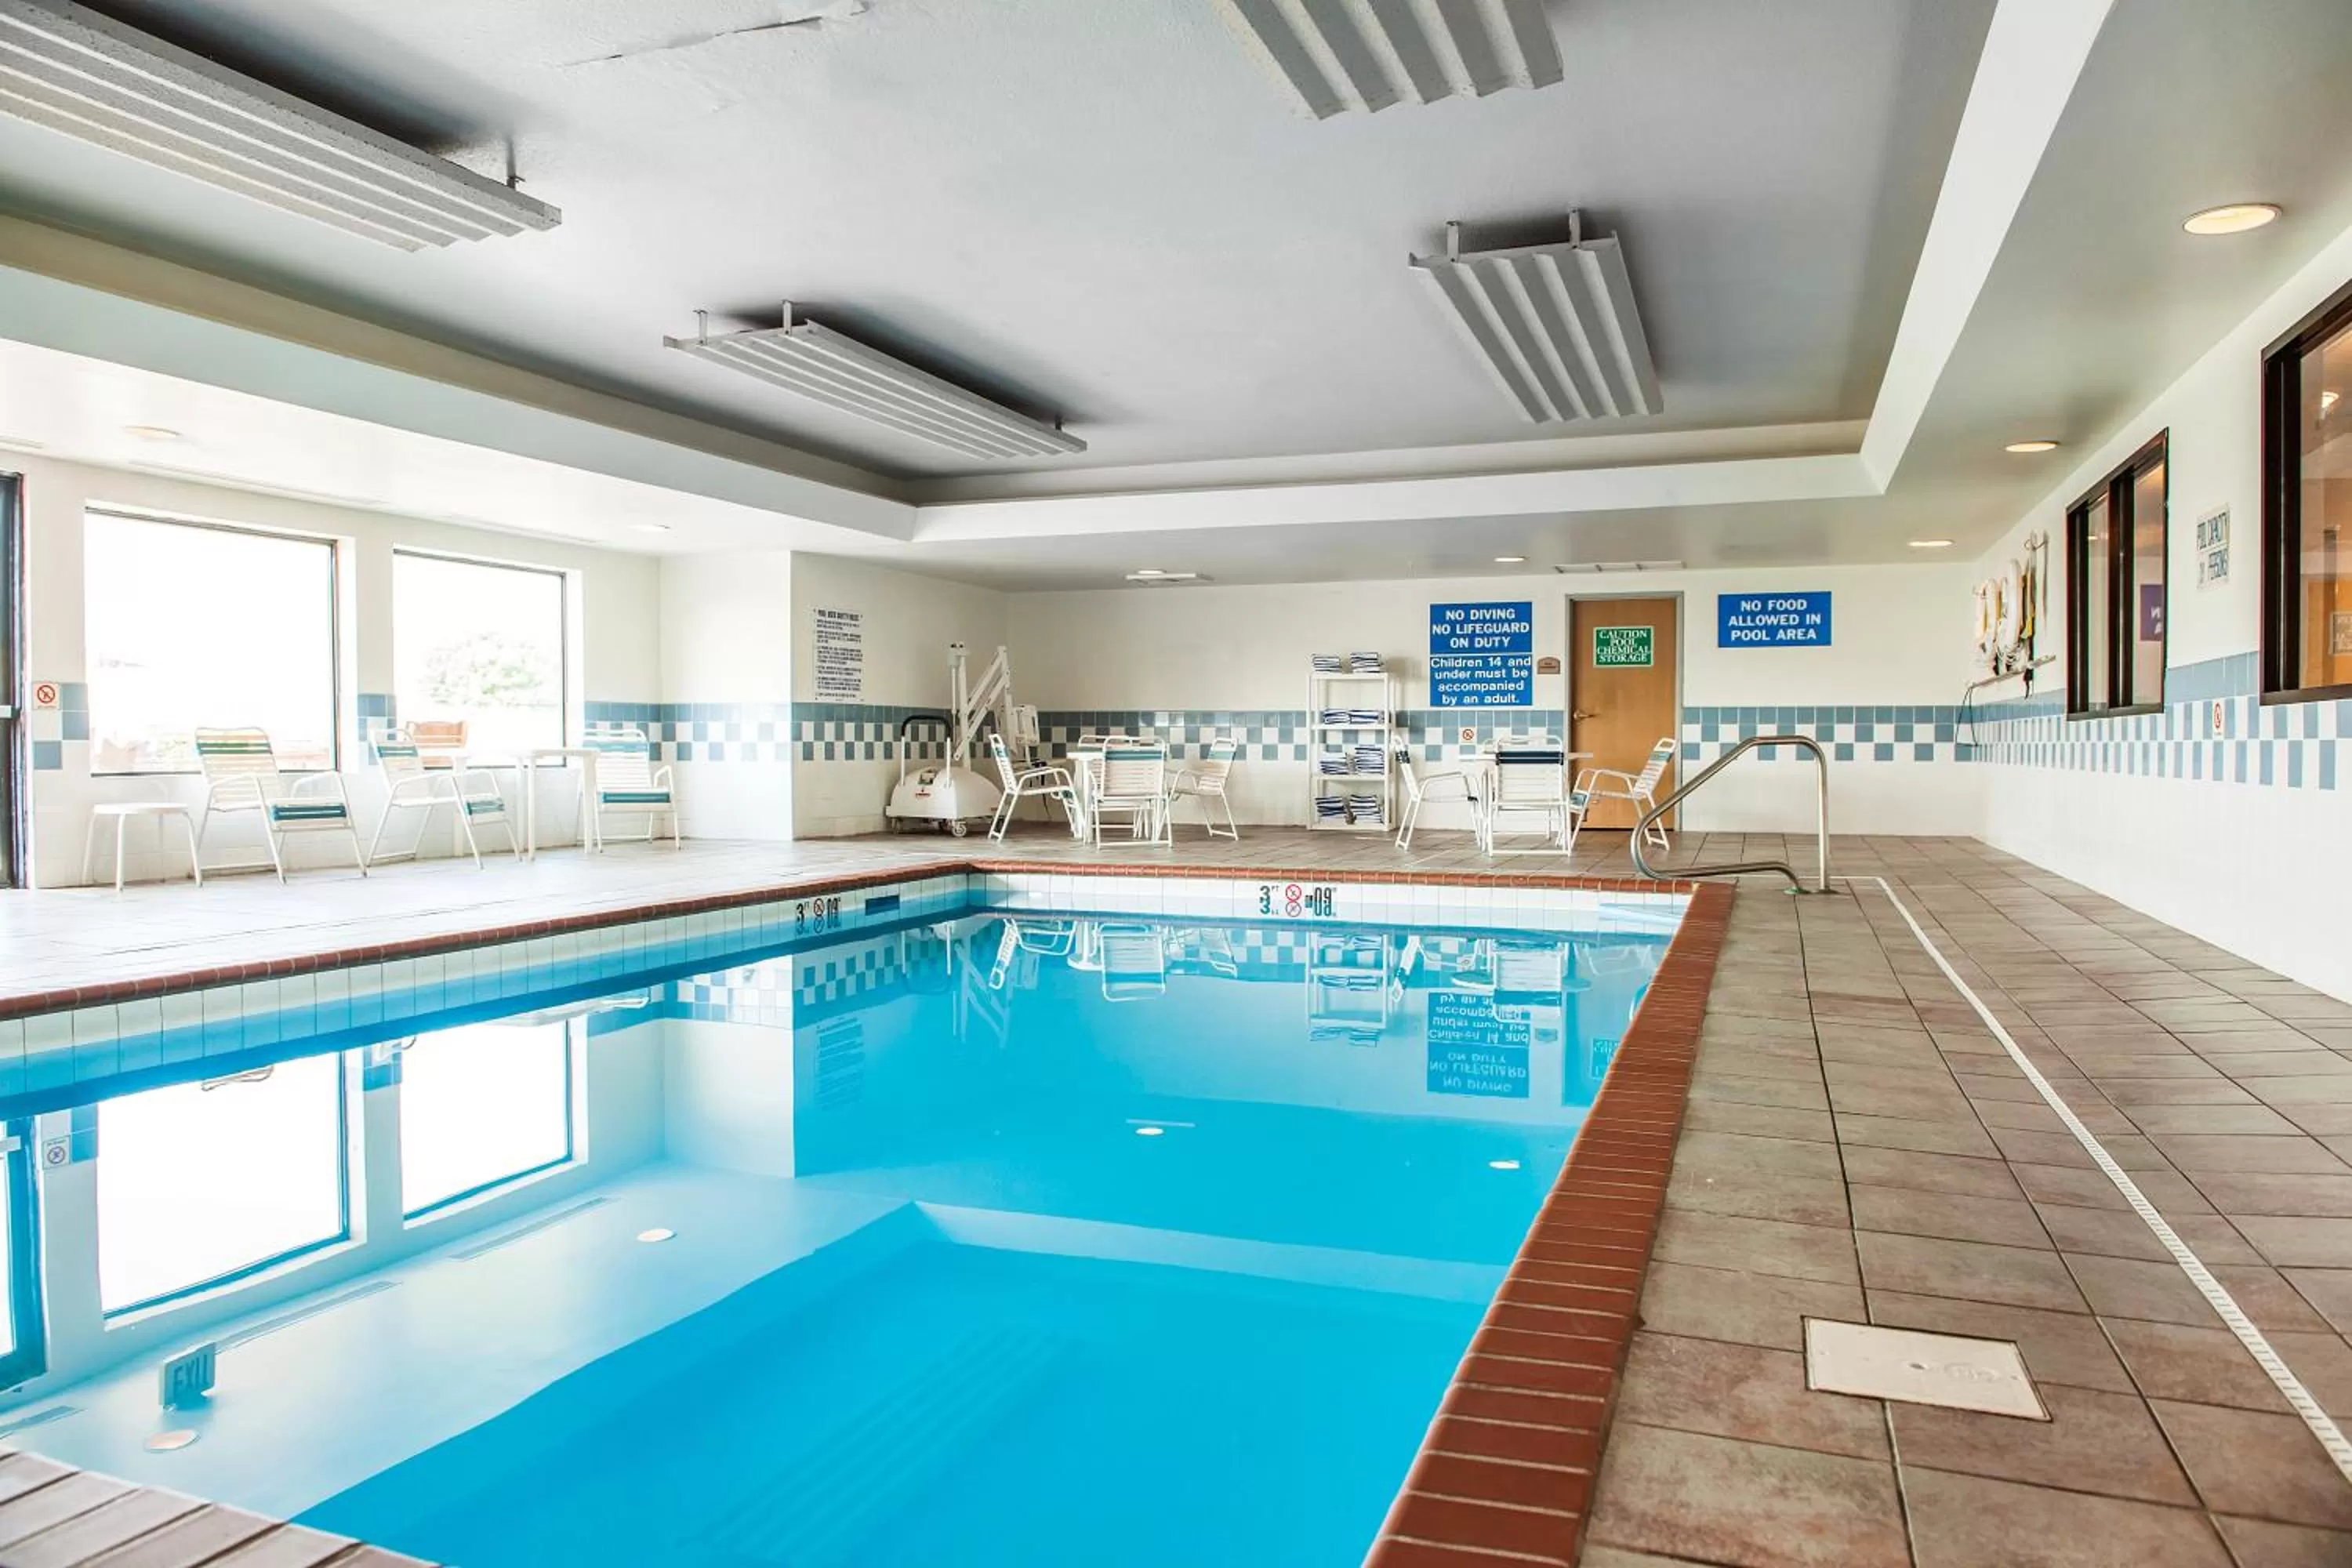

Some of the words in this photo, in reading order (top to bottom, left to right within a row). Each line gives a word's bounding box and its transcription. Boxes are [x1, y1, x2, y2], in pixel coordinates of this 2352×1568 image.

[1740, 600, 1762, 612] NO
[1768, 599, 1807, 612] FOOD
[1445, 609, 1465, 621] NO
[1470, 608, 1515, 620] DIVING
[1728, 614, 1800, 626] ALLOWED
[1806, 613, 1821, 625] IN
[1432, 624, 1451, 635] NO
[1456, 622, 1530, 634] LIFEGUARD
[1599, 630, 1647, 639] CAUTION
[1730, 630, 1770, 641] POOL
[1776, 628, 1817, 641] AREA
[1450, 637, 1468, 648] ON
[1475, 636, 1511, 648] DUTY
[1610, 638, 1637, 647] POOL
[1597, 645, 1650, 655] CHEMICAL
[1431, 657, 1483, 668] Children
[1487, 656, 1501, 666] 14
[1508, 656, 1531, 666] and
[1599, 653, 1648, 662] STORAGE
[1435, 670, 1472, 680] under
[1475, 669, 1506, 678] must
[1512, 668, 1529, 678] be
[1437, 680, 1525, 693] accompanied
[1441, 694, 1457, 706] by
[1483, 693, 1520, 703] adult.
